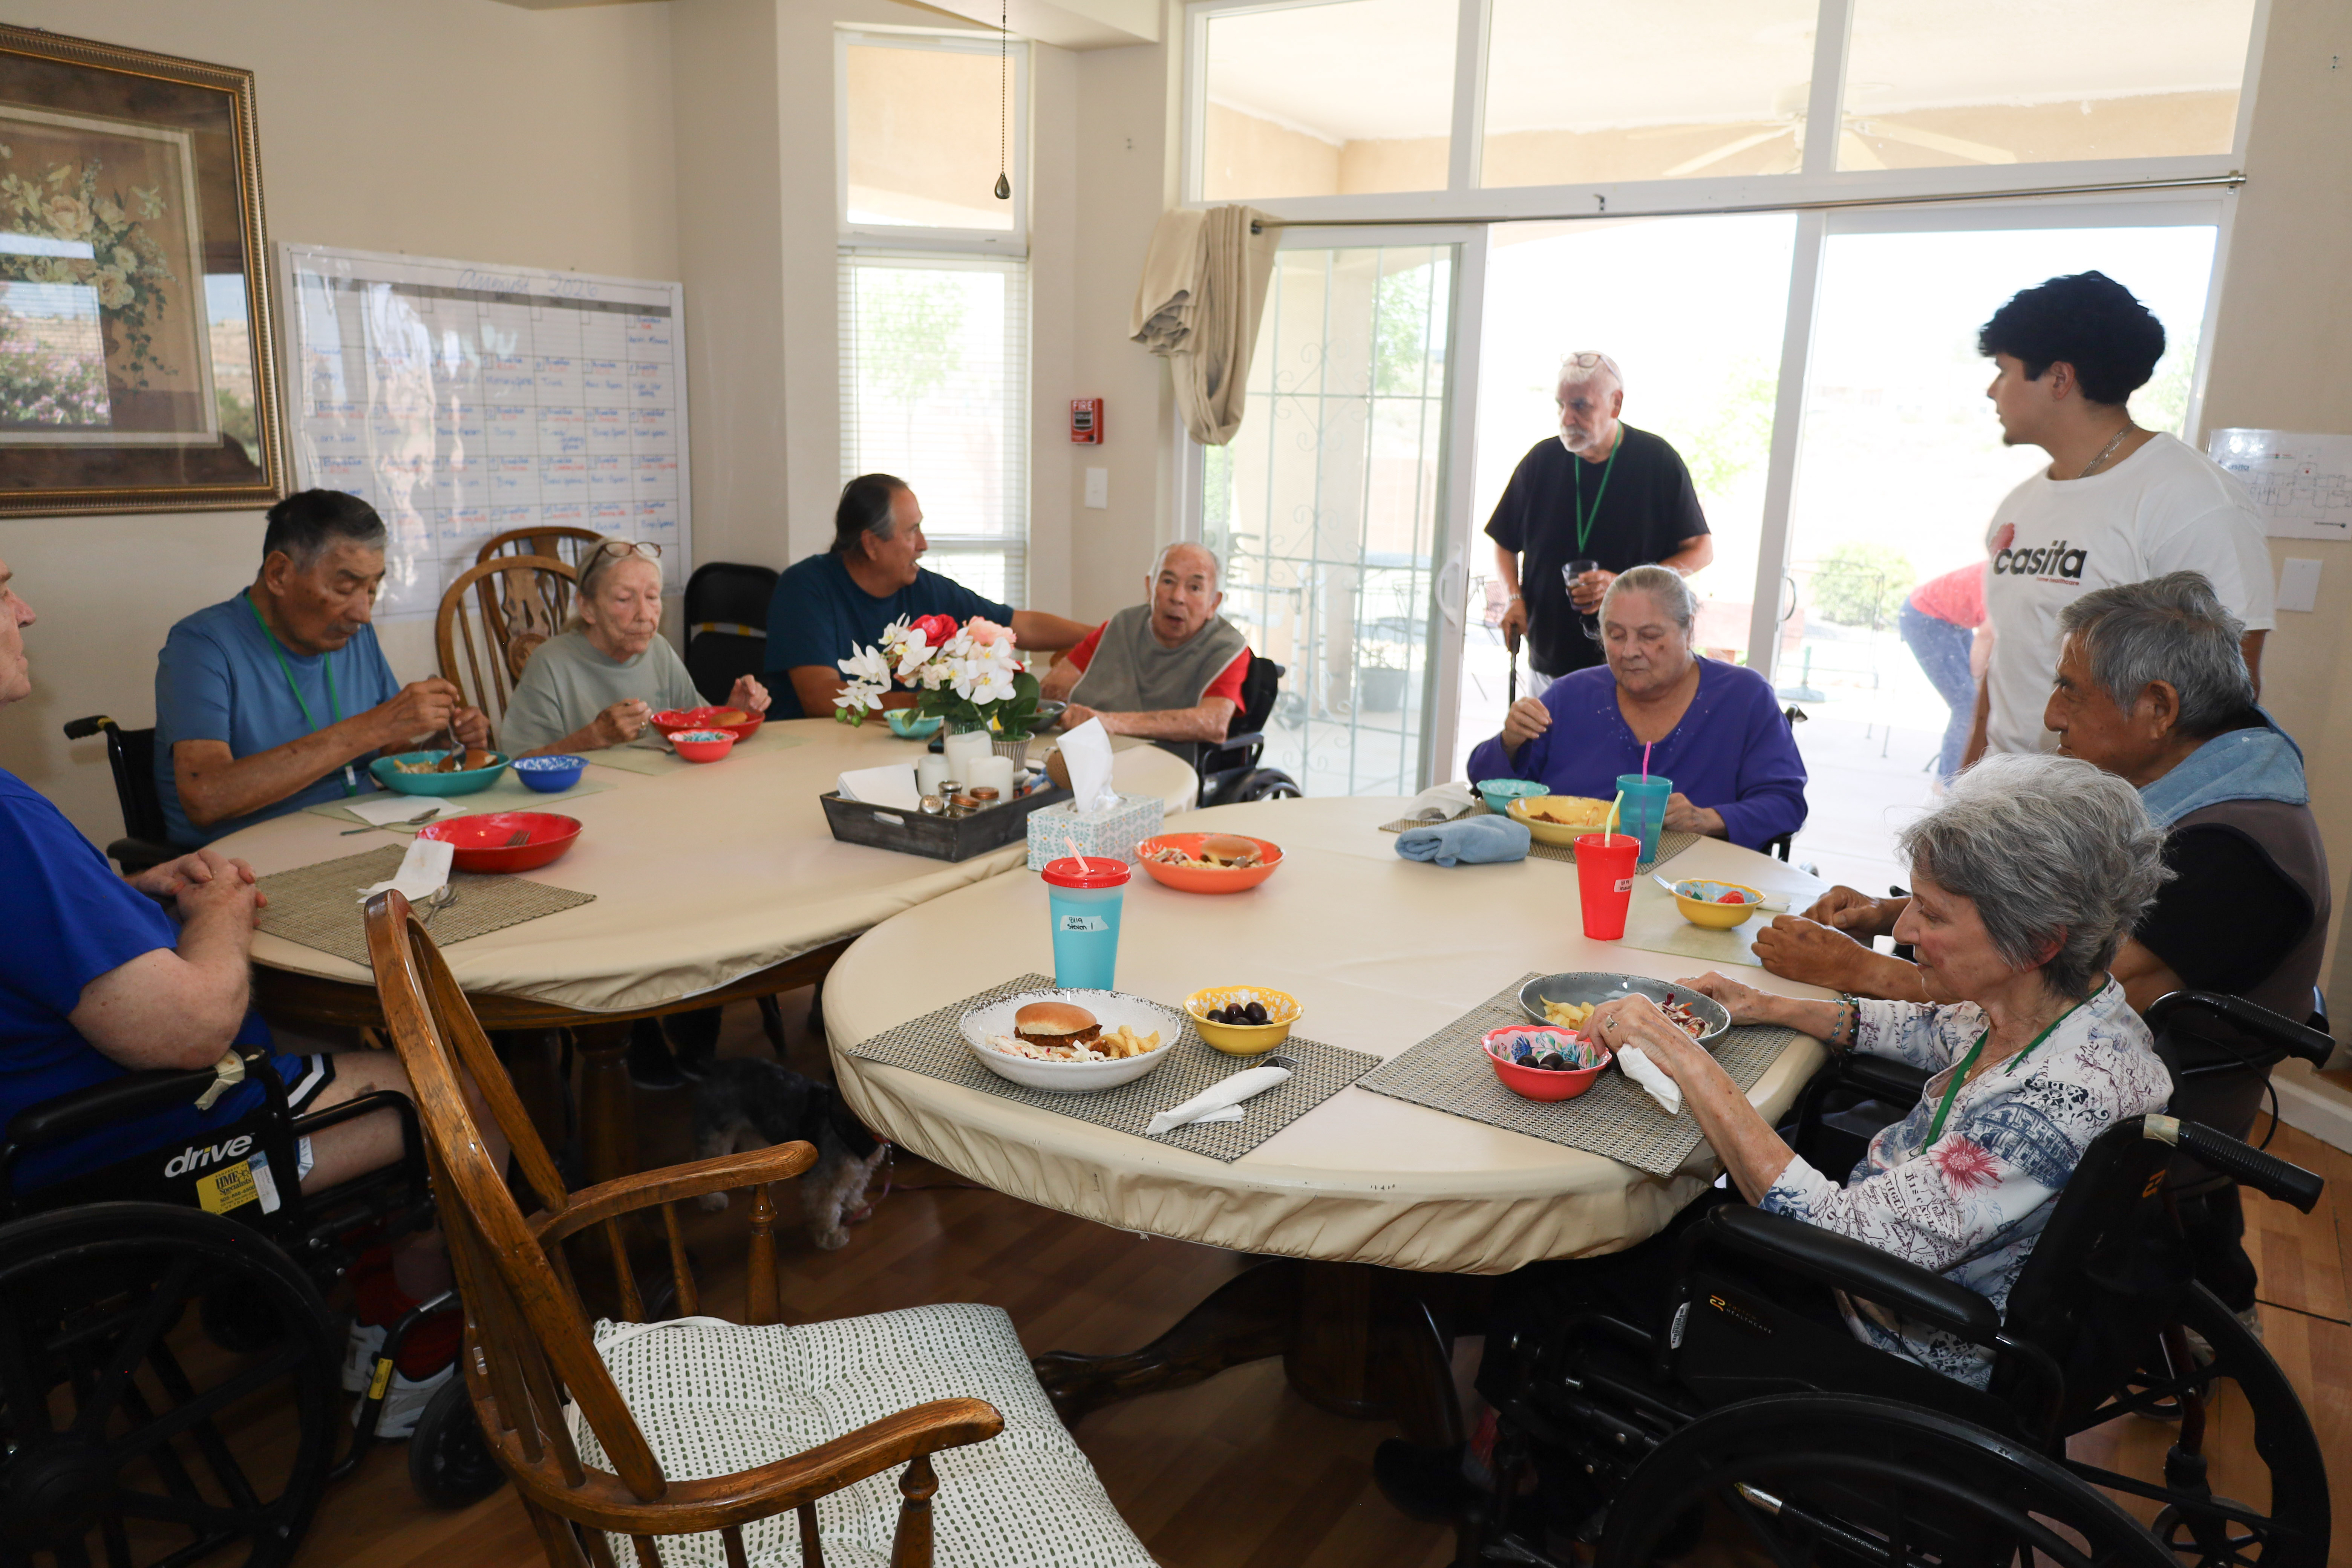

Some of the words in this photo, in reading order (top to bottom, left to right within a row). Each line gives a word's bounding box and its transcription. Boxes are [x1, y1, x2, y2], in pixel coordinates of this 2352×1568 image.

[547, 274, 599, 298] 2026
[1993, 540, 2087, 578] casita
[165, 1135, 252, 1178] drive
[216, 1171, 239, 1190] HME
[1726, 1308, 1772, 1334] HEALTHCARE
